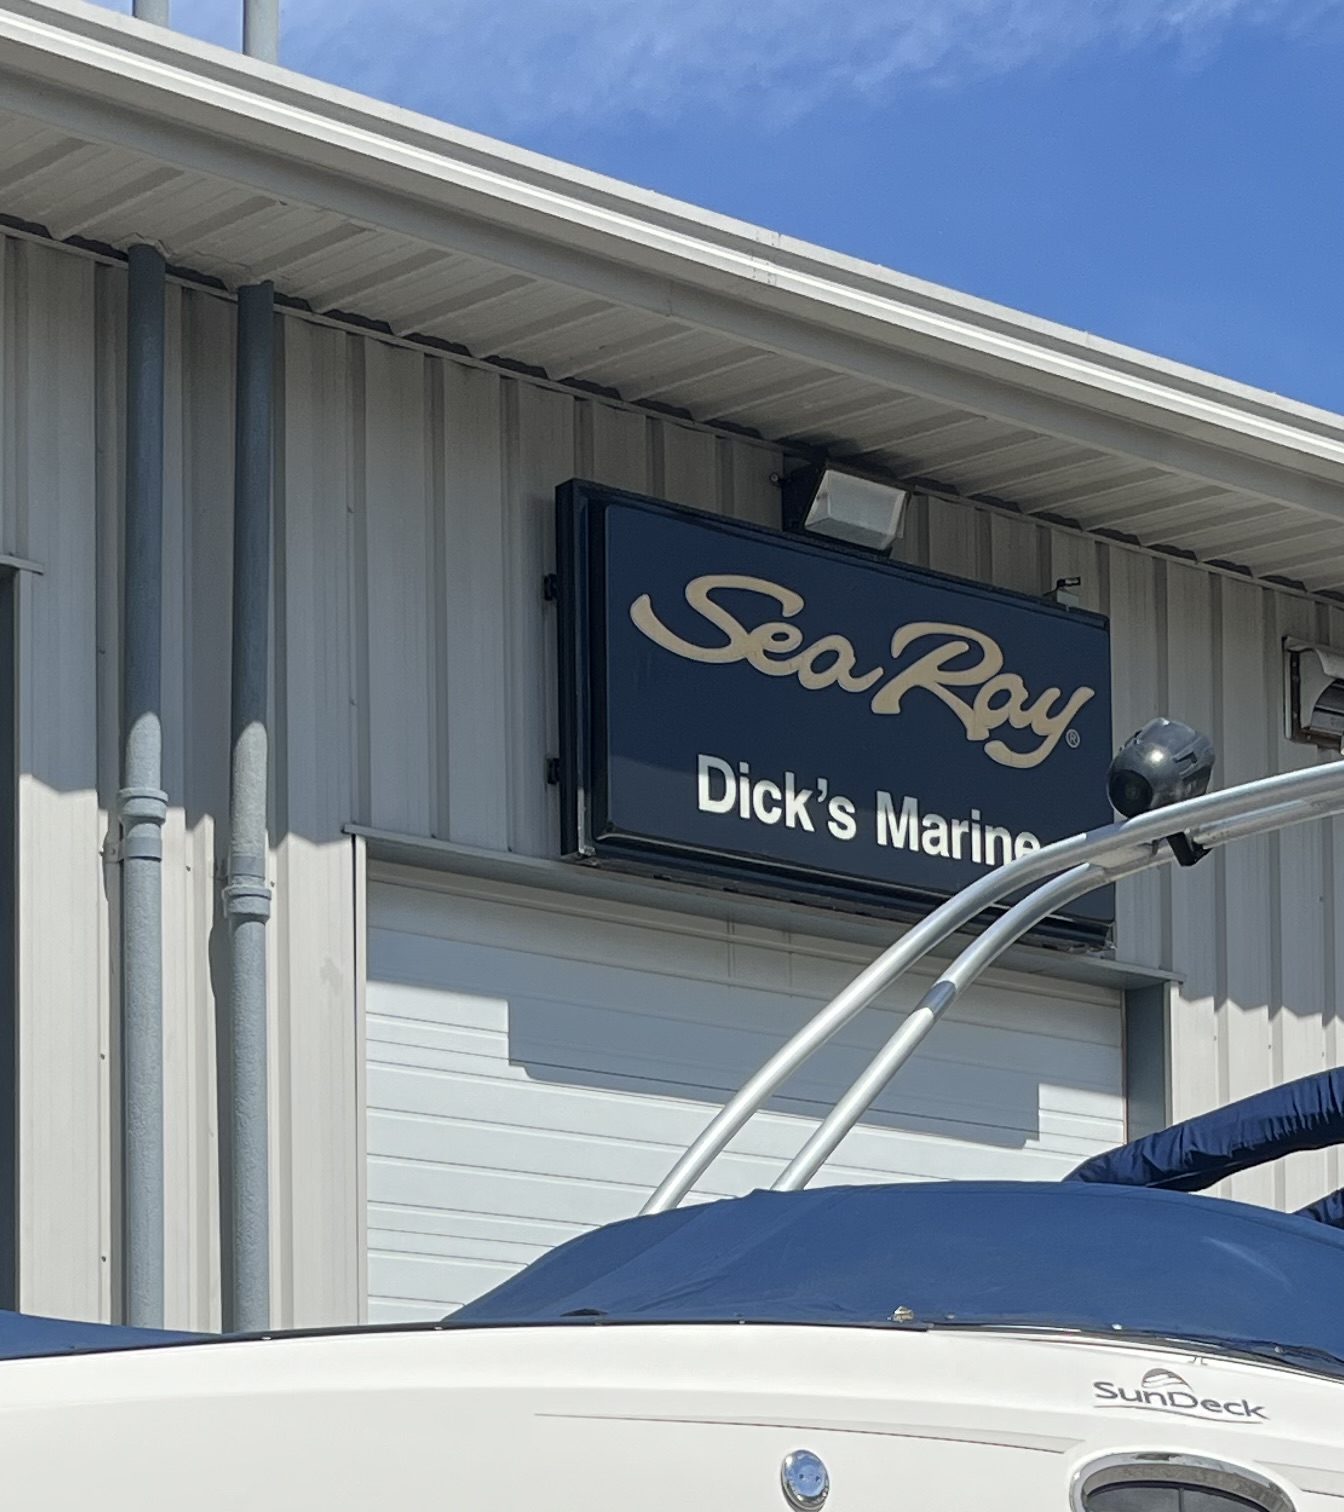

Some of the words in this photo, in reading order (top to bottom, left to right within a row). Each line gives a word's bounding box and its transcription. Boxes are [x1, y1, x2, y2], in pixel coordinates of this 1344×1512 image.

[630, 574, 884, 692] Sea
[697, 753, 857, 841] Dick's
[876, 790, 1041, 867] Marine
[1093, 1382, 1271, 1420] SunDeck
